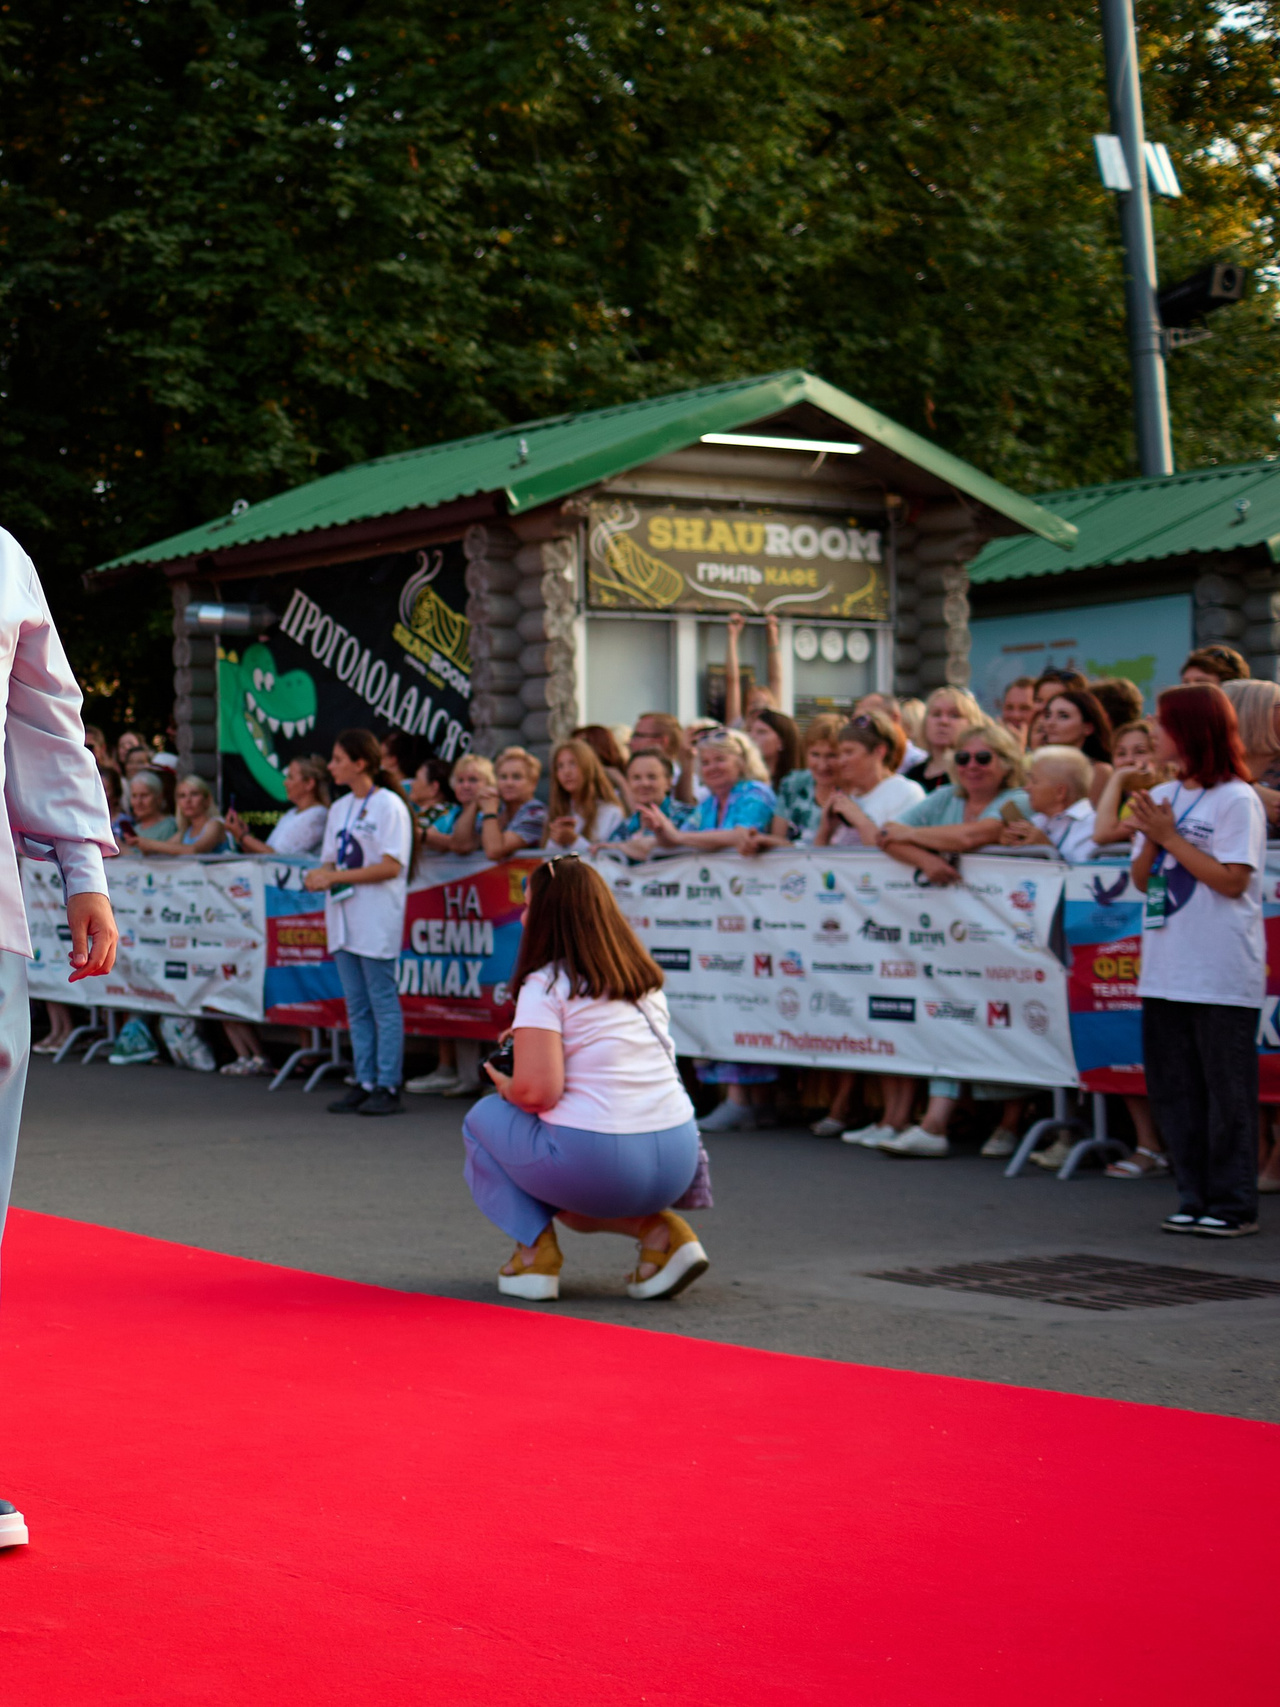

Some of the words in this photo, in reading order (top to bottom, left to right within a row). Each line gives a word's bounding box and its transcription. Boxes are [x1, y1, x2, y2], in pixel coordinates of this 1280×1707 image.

[647, 516, 882, 563] SHAUROOM
[696, 562, 763, 585] ГРИЛЬ
[764, 567, 818, 588] КАФЕ
[443, 884, 484, 919] НА
[410, 917, 494, 957] СЕМИ
